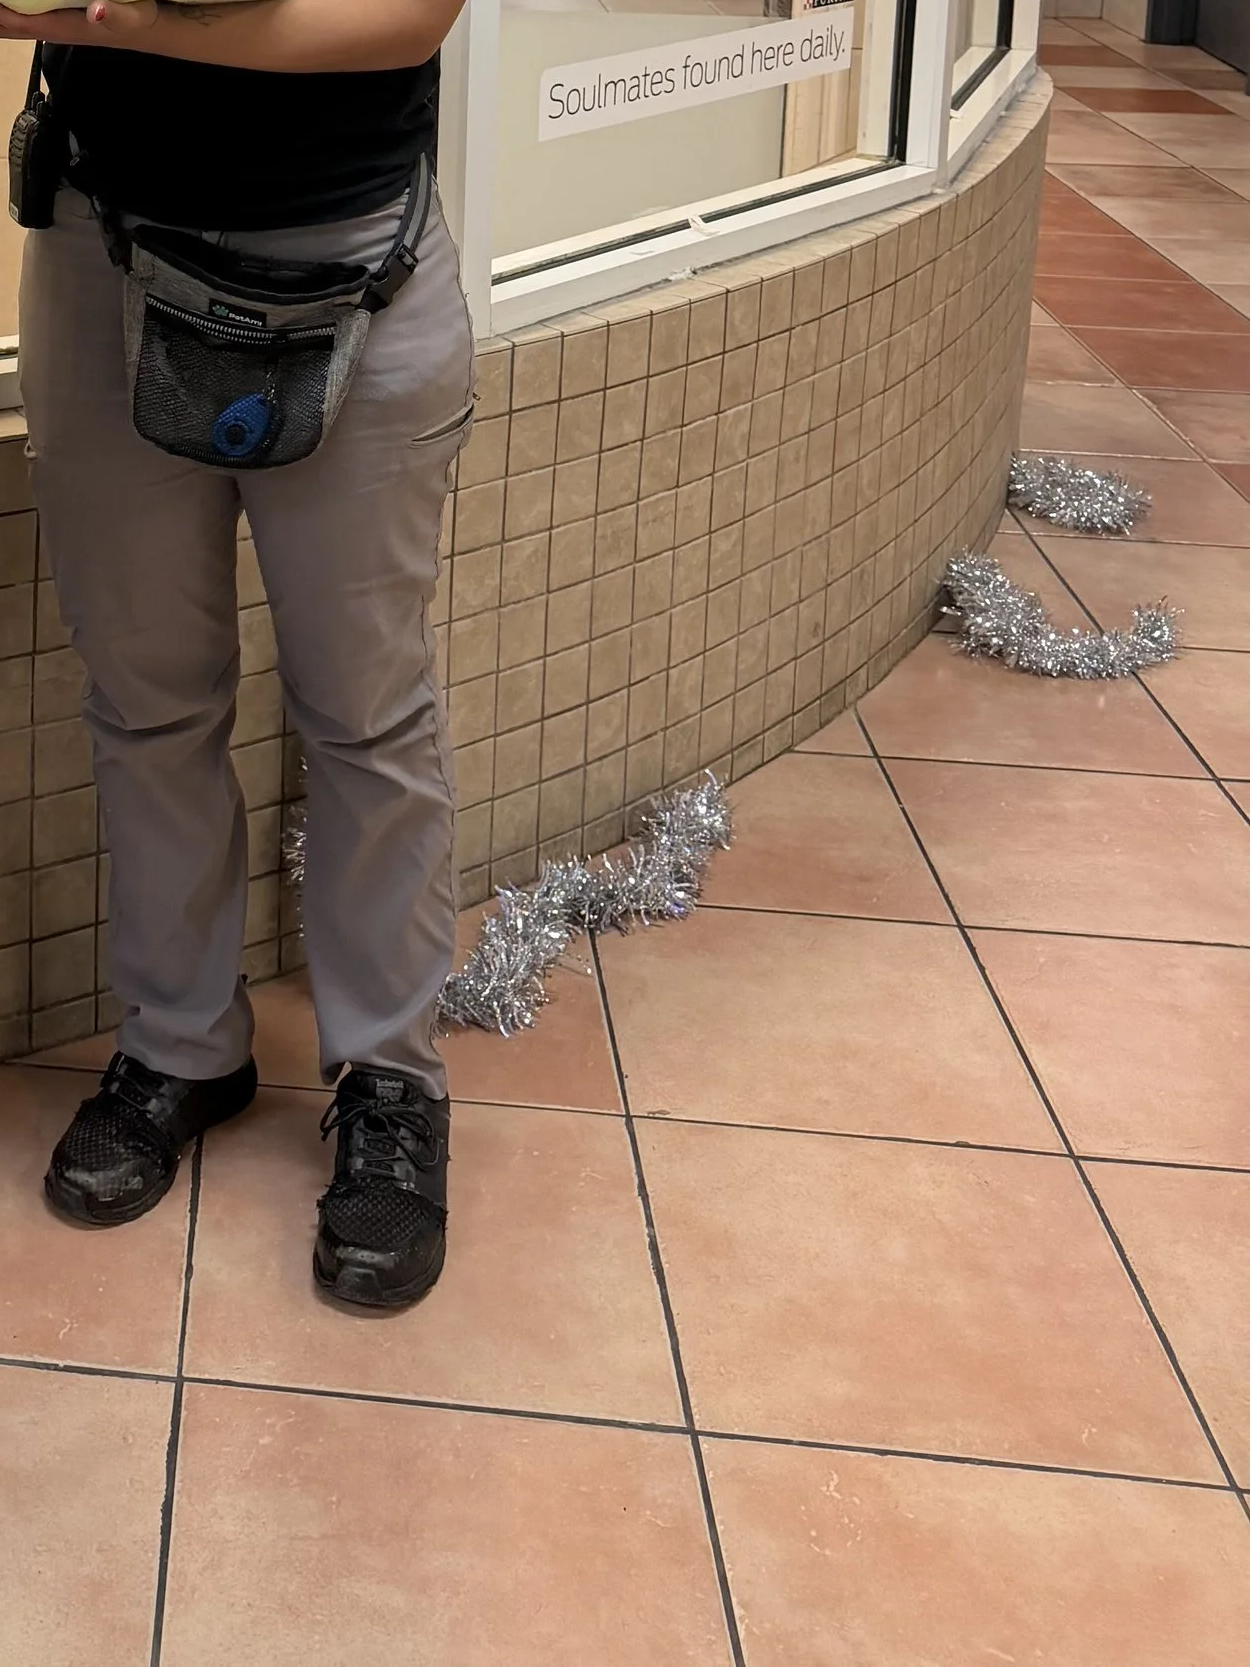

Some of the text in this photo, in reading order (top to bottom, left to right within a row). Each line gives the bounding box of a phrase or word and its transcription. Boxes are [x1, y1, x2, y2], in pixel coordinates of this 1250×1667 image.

[548, 23, 846, 120] Soulmates found here daily.
